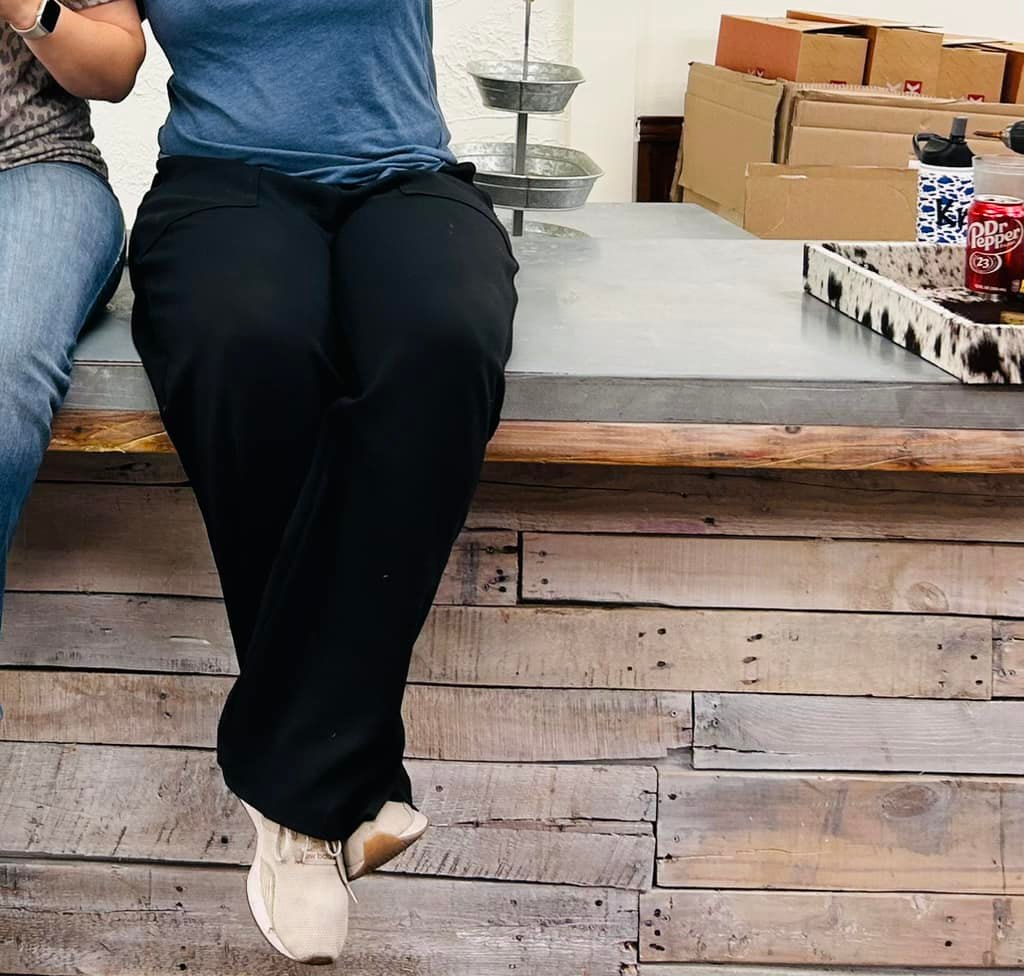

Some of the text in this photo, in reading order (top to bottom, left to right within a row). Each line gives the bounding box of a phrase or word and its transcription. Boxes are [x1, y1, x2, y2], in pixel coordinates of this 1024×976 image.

[970, 221, 1020, 251] Pepper
[983, 220, 1008, 236] Dr
[977, 256, 990, 269] 23
